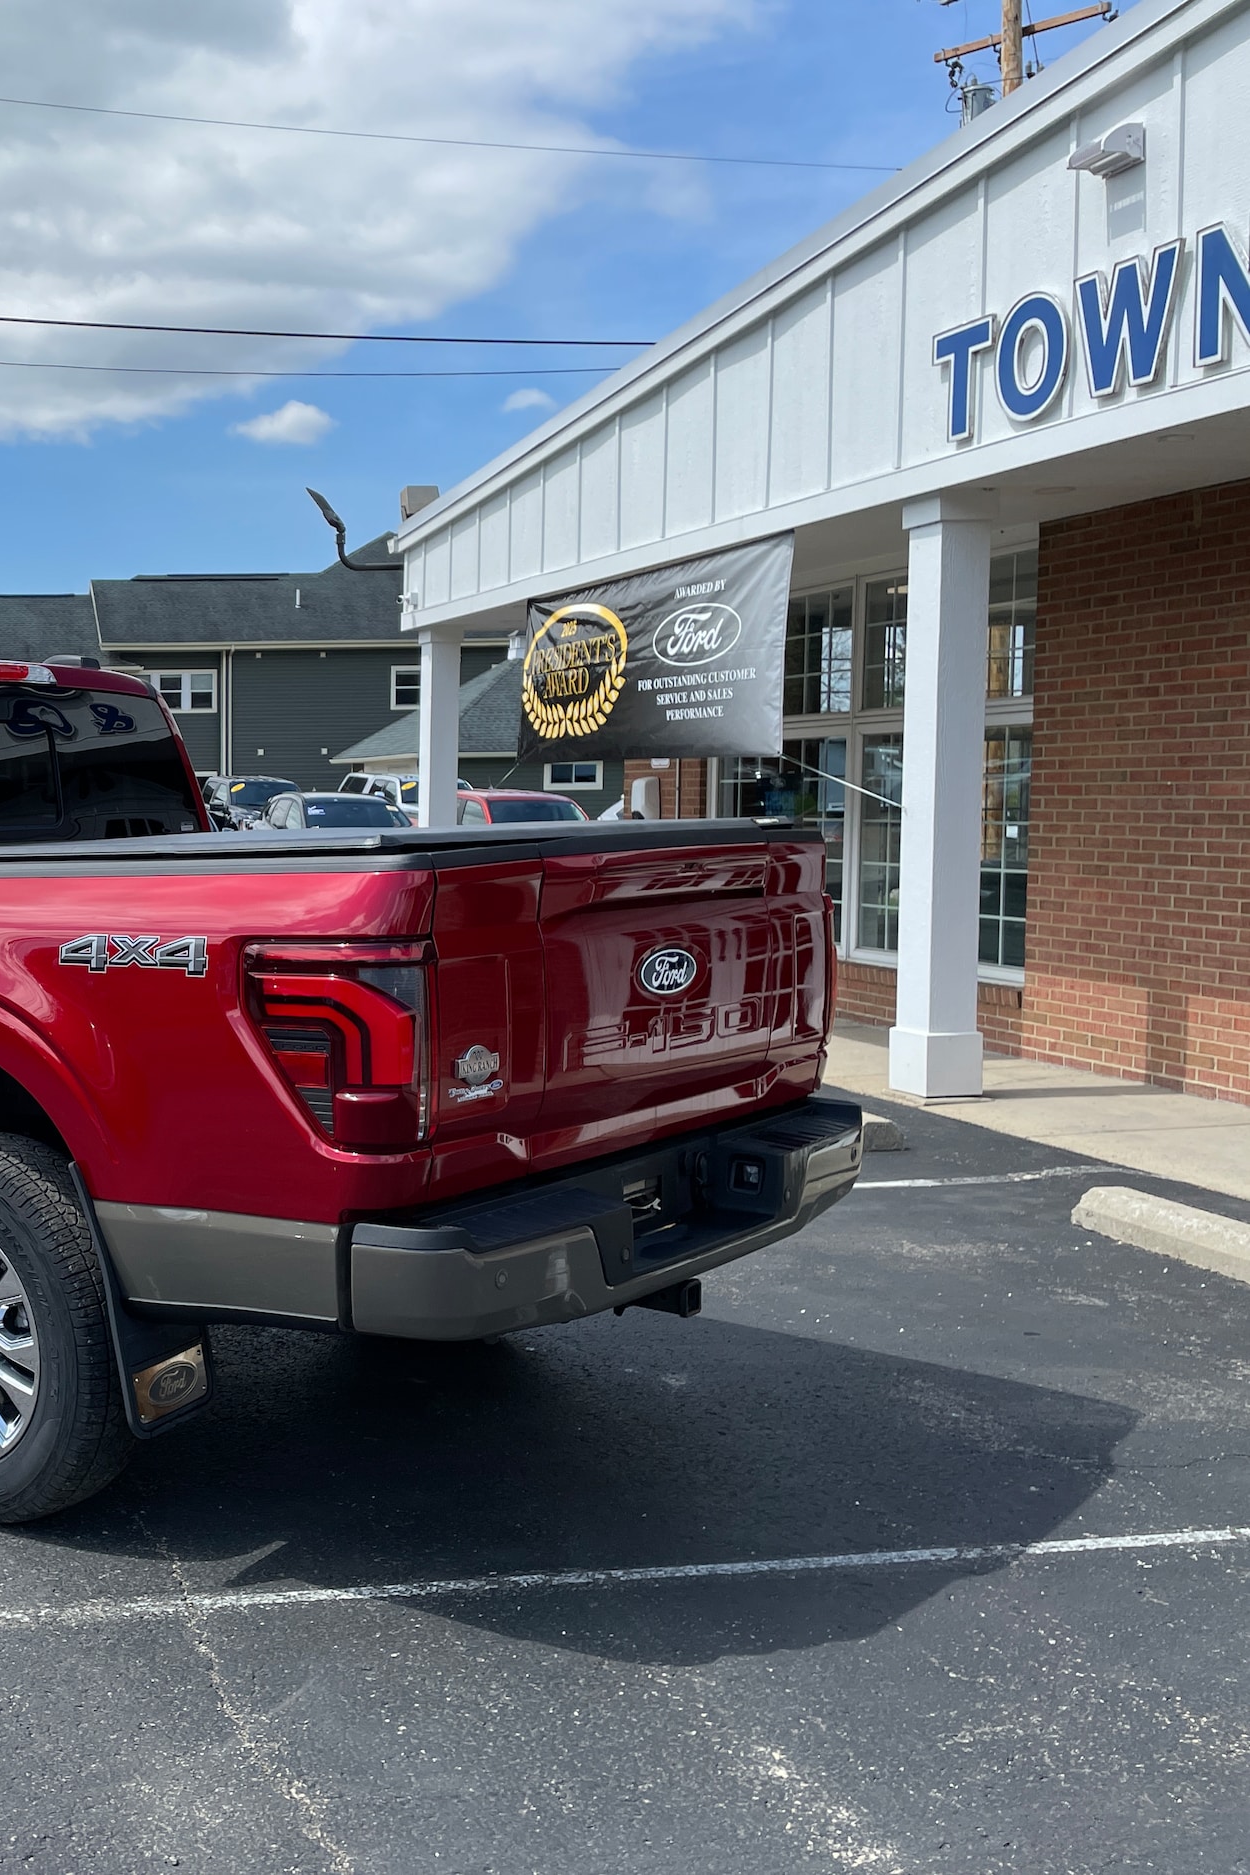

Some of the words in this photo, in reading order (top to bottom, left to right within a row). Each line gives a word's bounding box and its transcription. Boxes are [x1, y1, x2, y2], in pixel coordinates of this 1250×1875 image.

[931, 217, 1250, 443] TOWN
[674, 581, 713, 600] AWARDED
[714, 579, 727, 591] BY
[666, 611, 724, 656] Ford
[531, 633, 616, 676] PRESIDENT'S
[543, 666, 590, 699] AWARD
[637, 678, 653, 692] FOR
[653, 673, 708, 690] OUTSTANDING
[708, 667, 756, 684] CUSTOMER
[656, 691, 688, 705] SERVICE
[689, 690, 706, 703] AND
[707, 687, 734, 700] SALES
[666, 705, 724, 721] PERFORMANCE
[651, 955, 688, 988] Ford
[562, 996, 762, 1072] F-150
[462, 1063, 477, 1074] KING
[477, 1056, 498, 1072] RANCH
[159, 1369, 187, 1400] Ford
